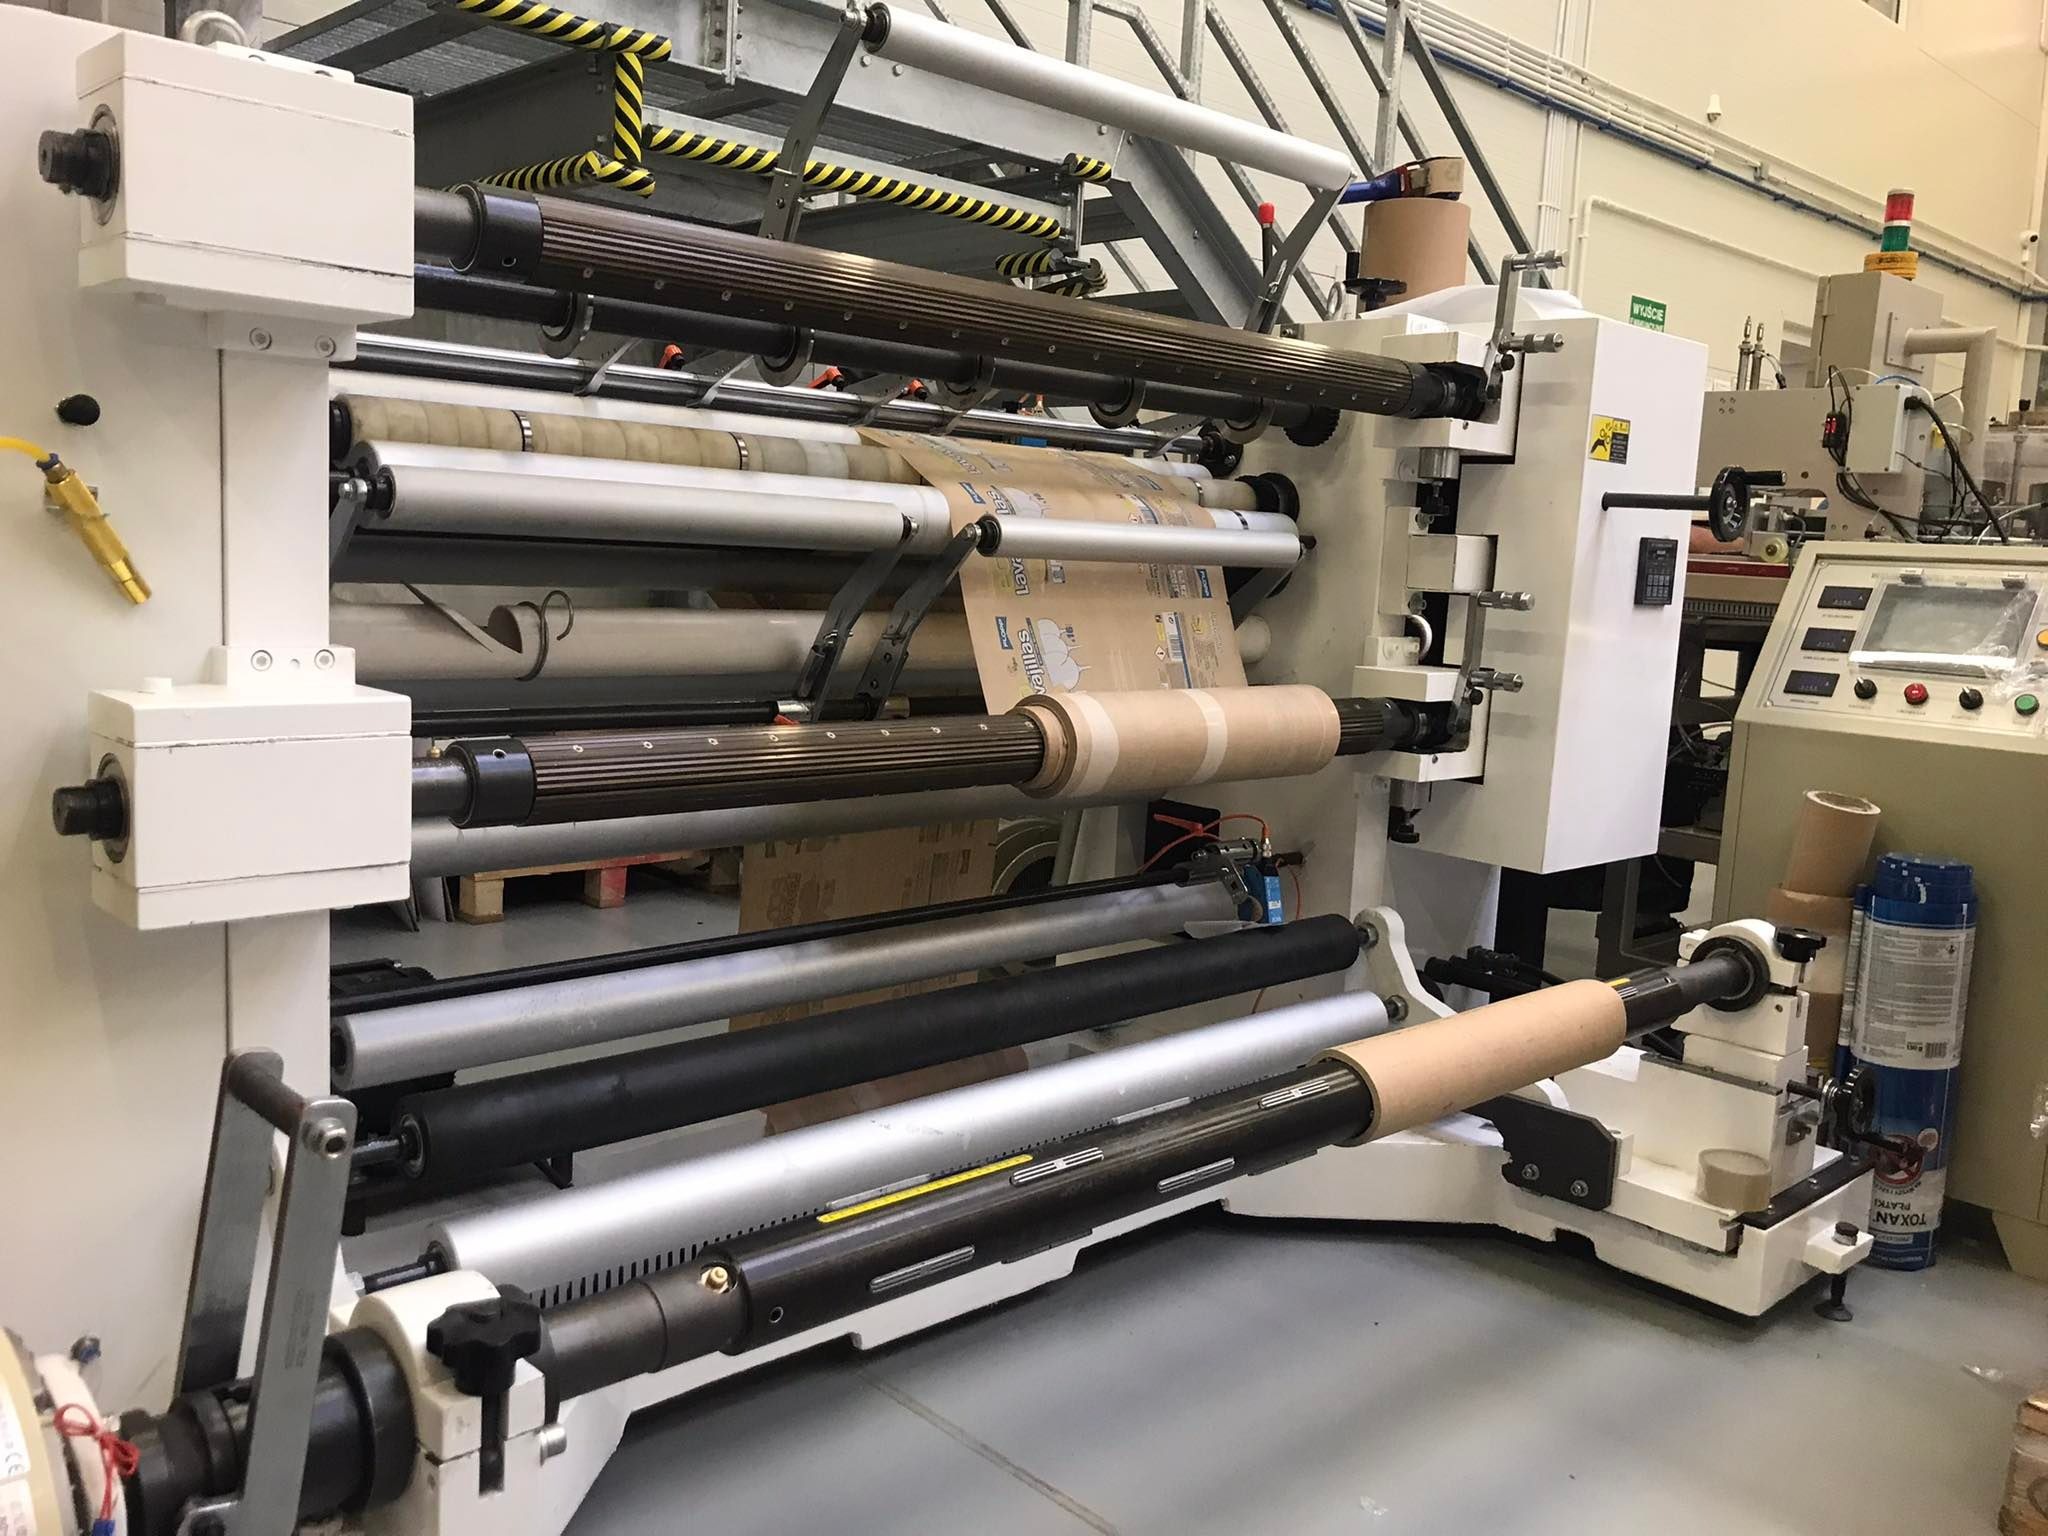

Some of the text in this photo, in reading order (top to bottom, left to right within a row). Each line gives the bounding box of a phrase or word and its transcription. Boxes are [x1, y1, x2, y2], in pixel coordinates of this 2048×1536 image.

[1633, 302, 1664, 322] WYJŚCIE
[1873, 1198, 1911, 1211] PŁATKI
[1875, 1211, 1927, 1226] TOXAN
